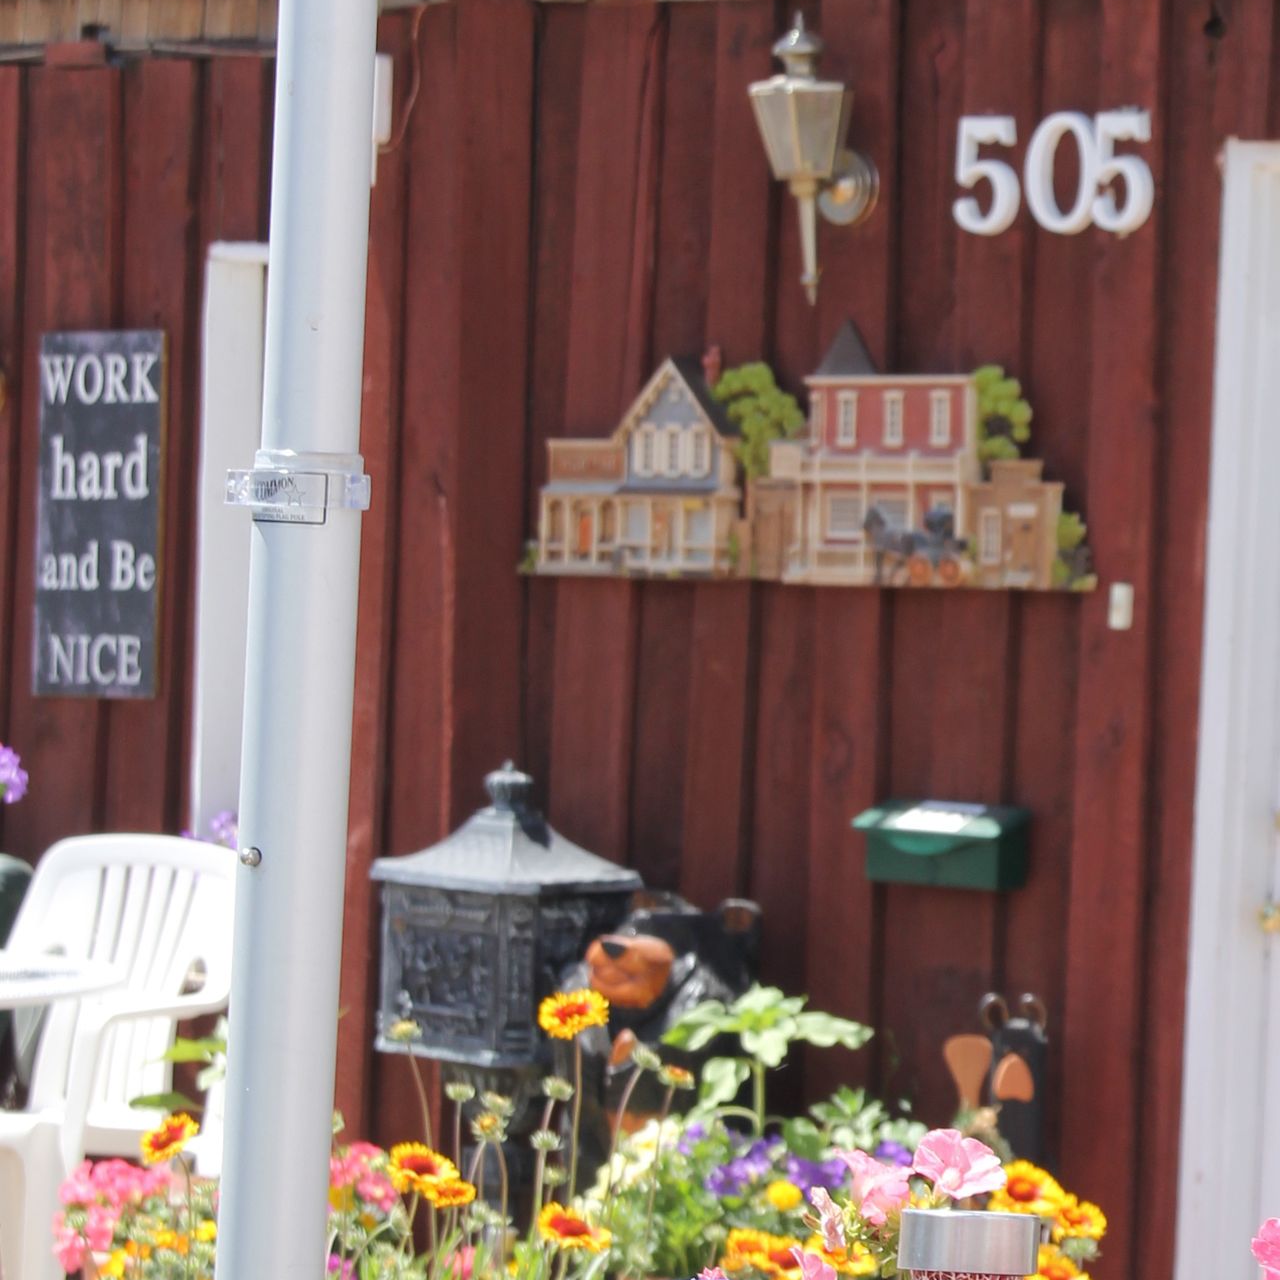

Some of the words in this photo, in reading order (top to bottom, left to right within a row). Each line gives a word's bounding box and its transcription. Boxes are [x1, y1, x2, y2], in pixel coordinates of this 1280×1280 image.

[952, 107, 1155, 236] 505
[42, 353, 159, 405] WORK
[50, 433, 149, 499] hard
[42, 540, 99, 591] and
[111, 540, 155, 591] Be
[48, 634, 142, 685] NICE
